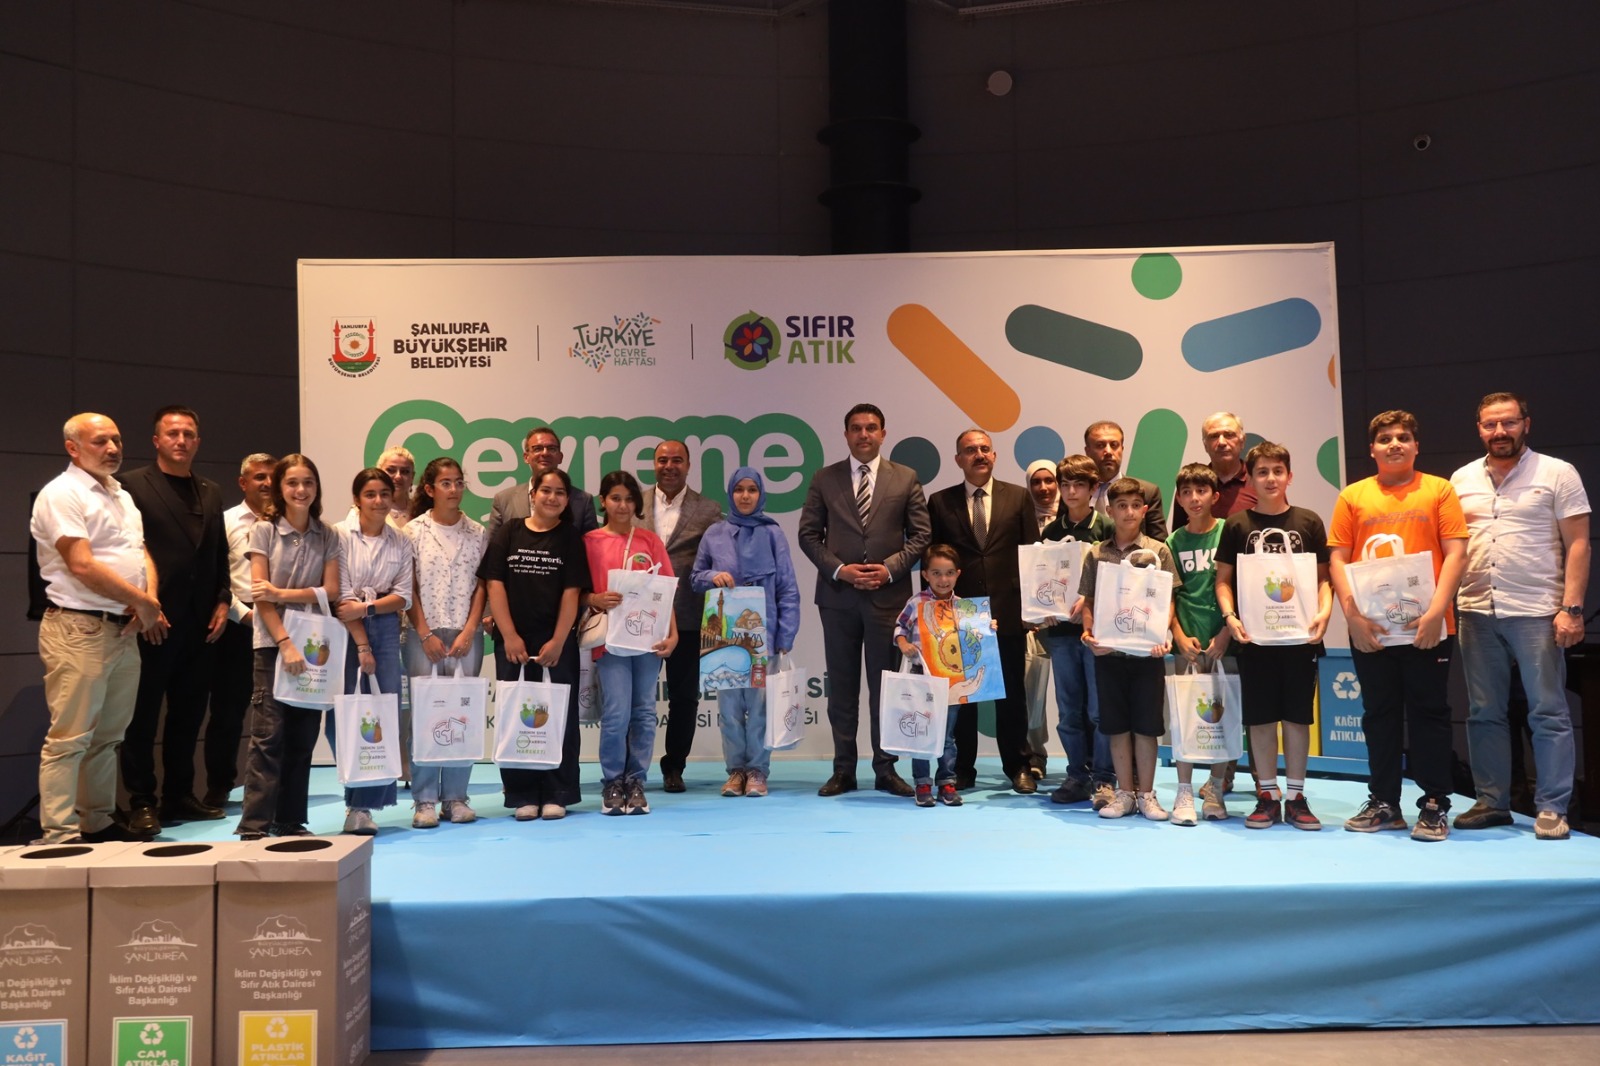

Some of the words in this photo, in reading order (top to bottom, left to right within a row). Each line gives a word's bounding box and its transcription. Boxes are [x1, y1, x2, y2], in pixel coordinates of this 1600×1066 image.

[411, 322, 490, 337] ŞANLIURFA
[785, 315, 855, 338] SIFIR
[573, 321, 656, 349] TÜRKİYE
[393, 337, 508, 354] BÜYÜKŞEHİR
[787, 340, 856, 364] ATIK
[411, 356, 492, 369] BELEDİYESİ
[614, 357, 656, 366] HAFTASI
[234, 968, 257, 978] İklim
[259, 968, 308, 980] Değişikliği
[6, 978, 58, 988] Değişikliği
[110, 974, 132, 984] İklim
[134, 974, 184, 985] Değişikliği
[240, 980, 260, 989] Sıfır
[262, 980, 280, 989] Atık
[282, 979, 316, 988] Dairesi
[31, 988, 66, 997] Dairesi
[116, 986, 136, 994] Sıfır
[136, 986, 156, 994] Atık
[158, 984, 192, 993] Dairesi
[128, 996, 178, 1006] Başkanlığı
[253, 991, 302, 1001] Başkanlığı
[1, 1000, 52, 1010] Başkanlığı
[252, 1042, 304, 1052] PLASTİK
[6, 1052, 47, 1063] KAĞIT
[137, 1050, 167, 1058] CAM
[251, 1052, 305, 1062] ATIKLAR
